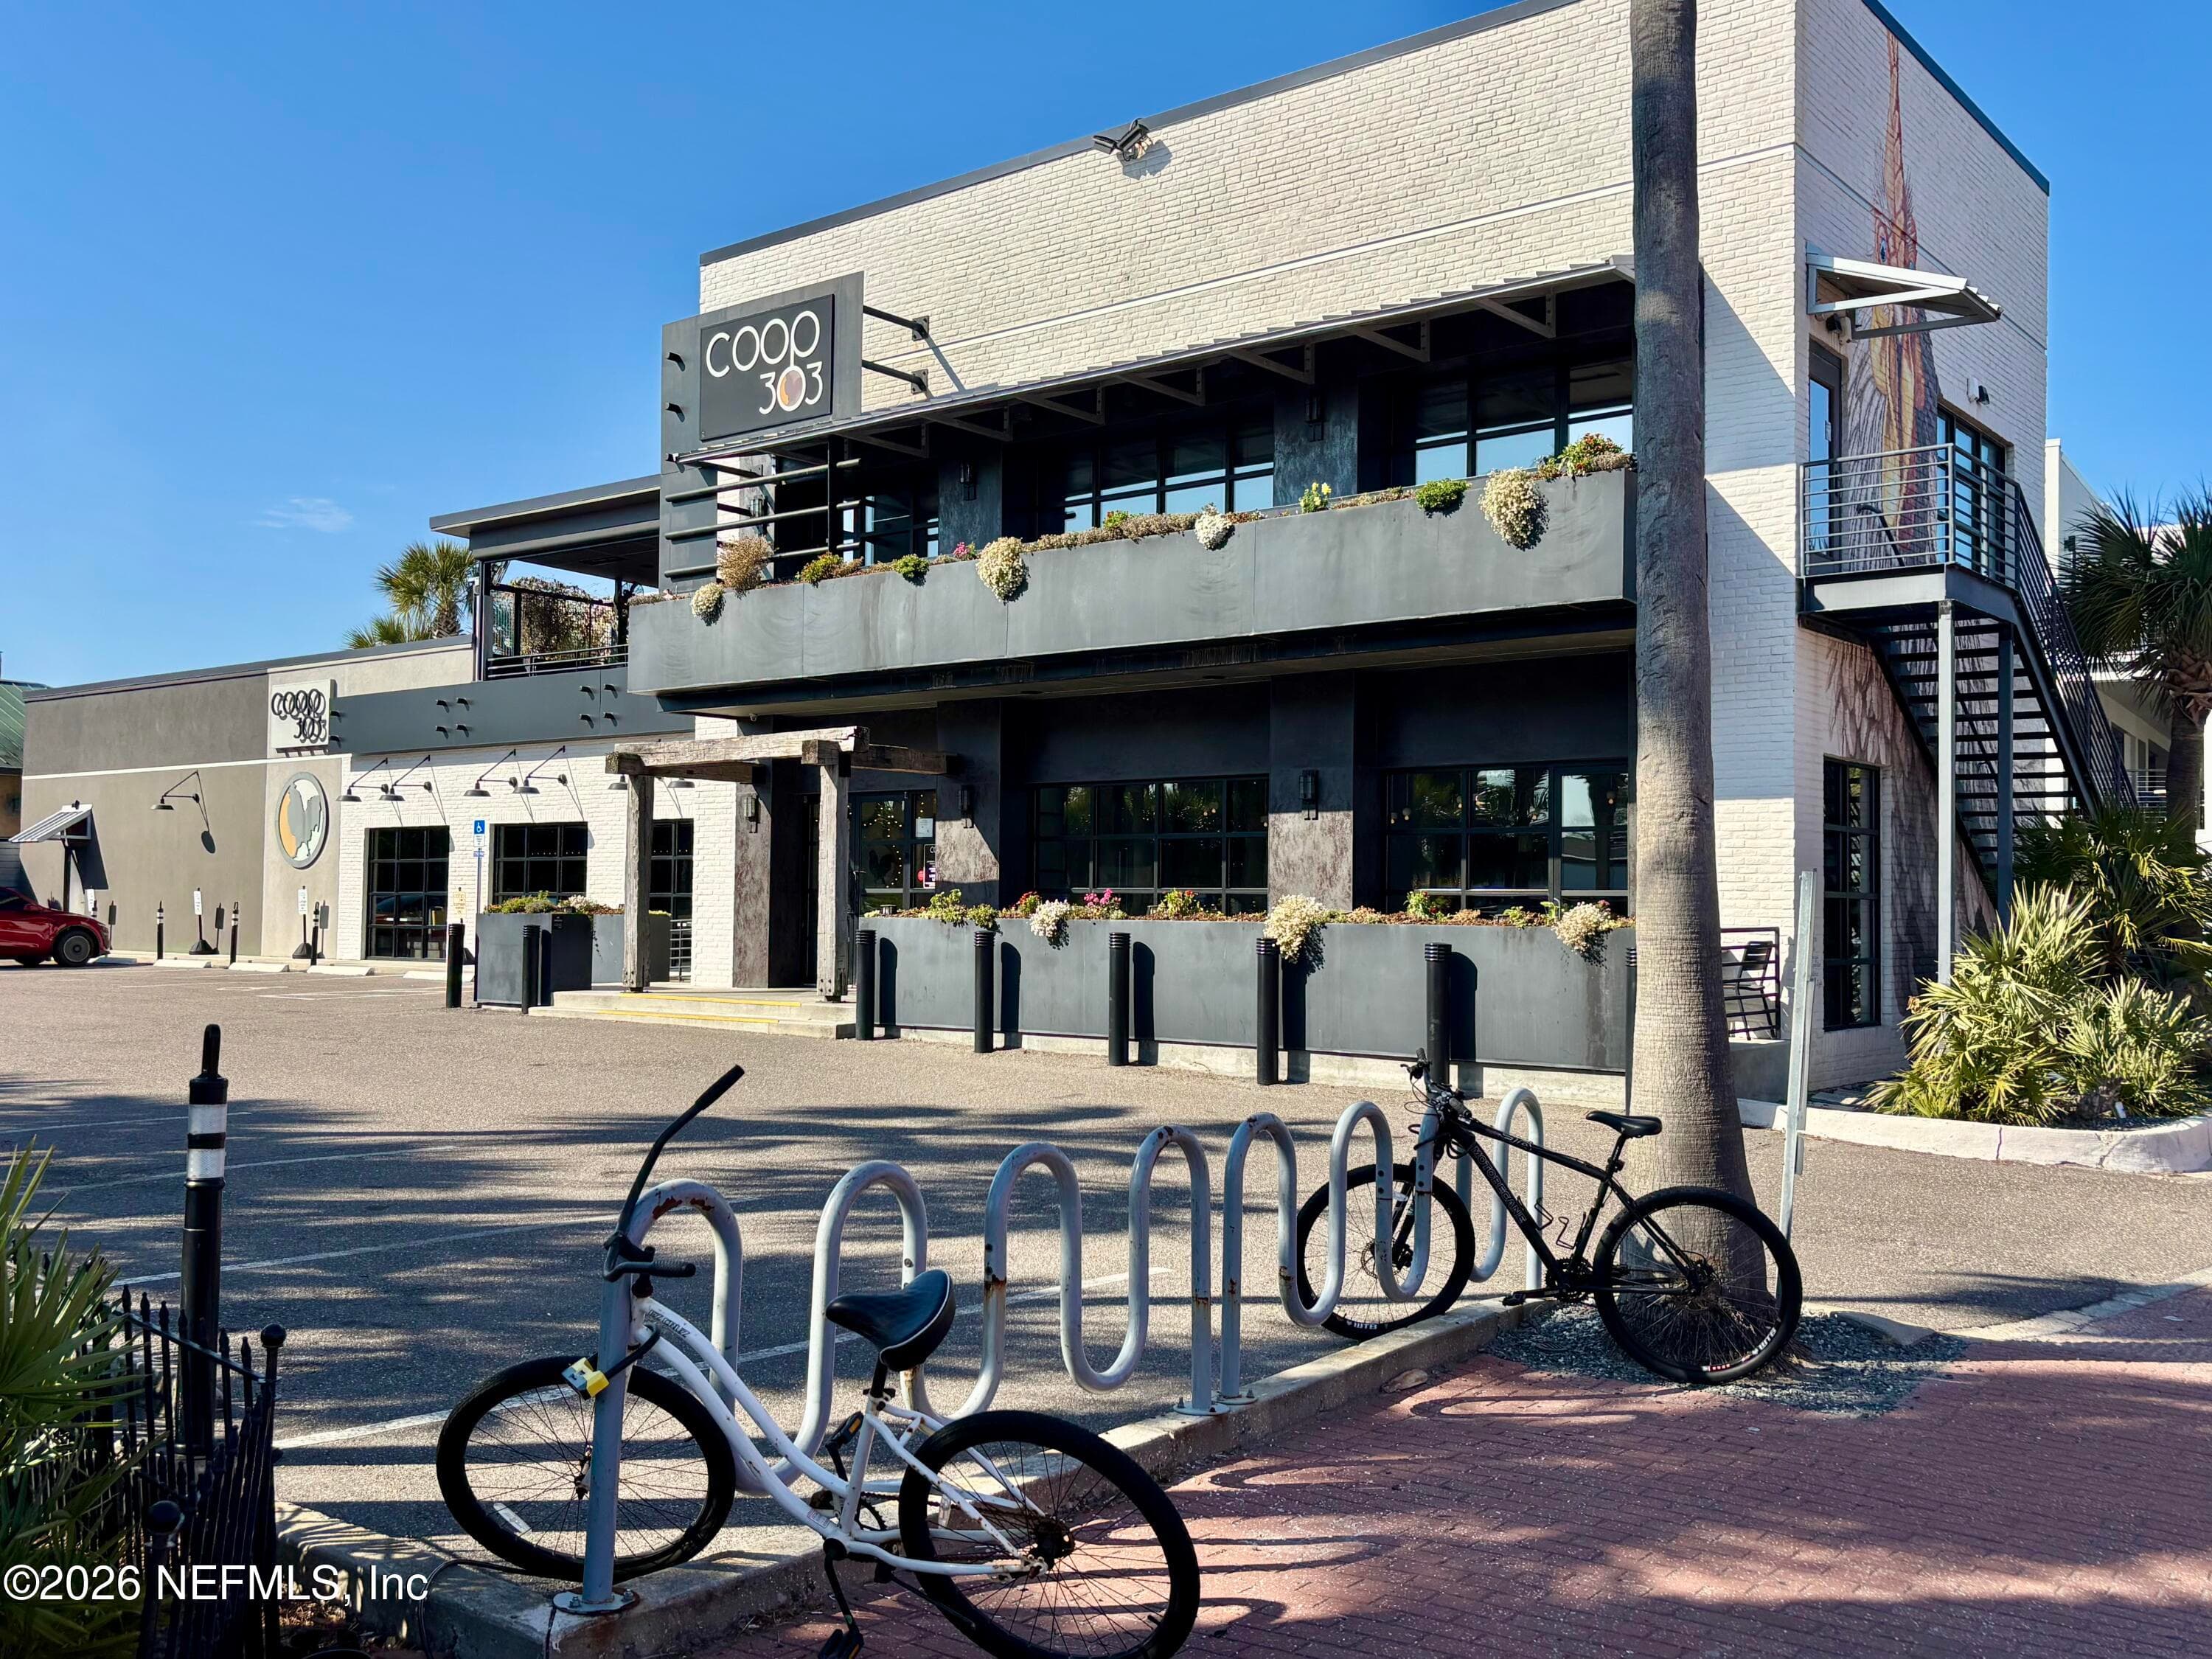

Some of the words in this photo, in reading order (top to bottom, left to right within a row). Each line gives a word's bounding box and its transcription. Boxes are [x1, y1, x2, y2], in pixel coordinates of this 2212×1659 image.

[759, 361, 823, 414] 303
[293, 714, 323, 740] 303
[1472, 1146, 1528, 1224] MOTOBECANE
[1758, 1327, 1777, 1350] WTB
